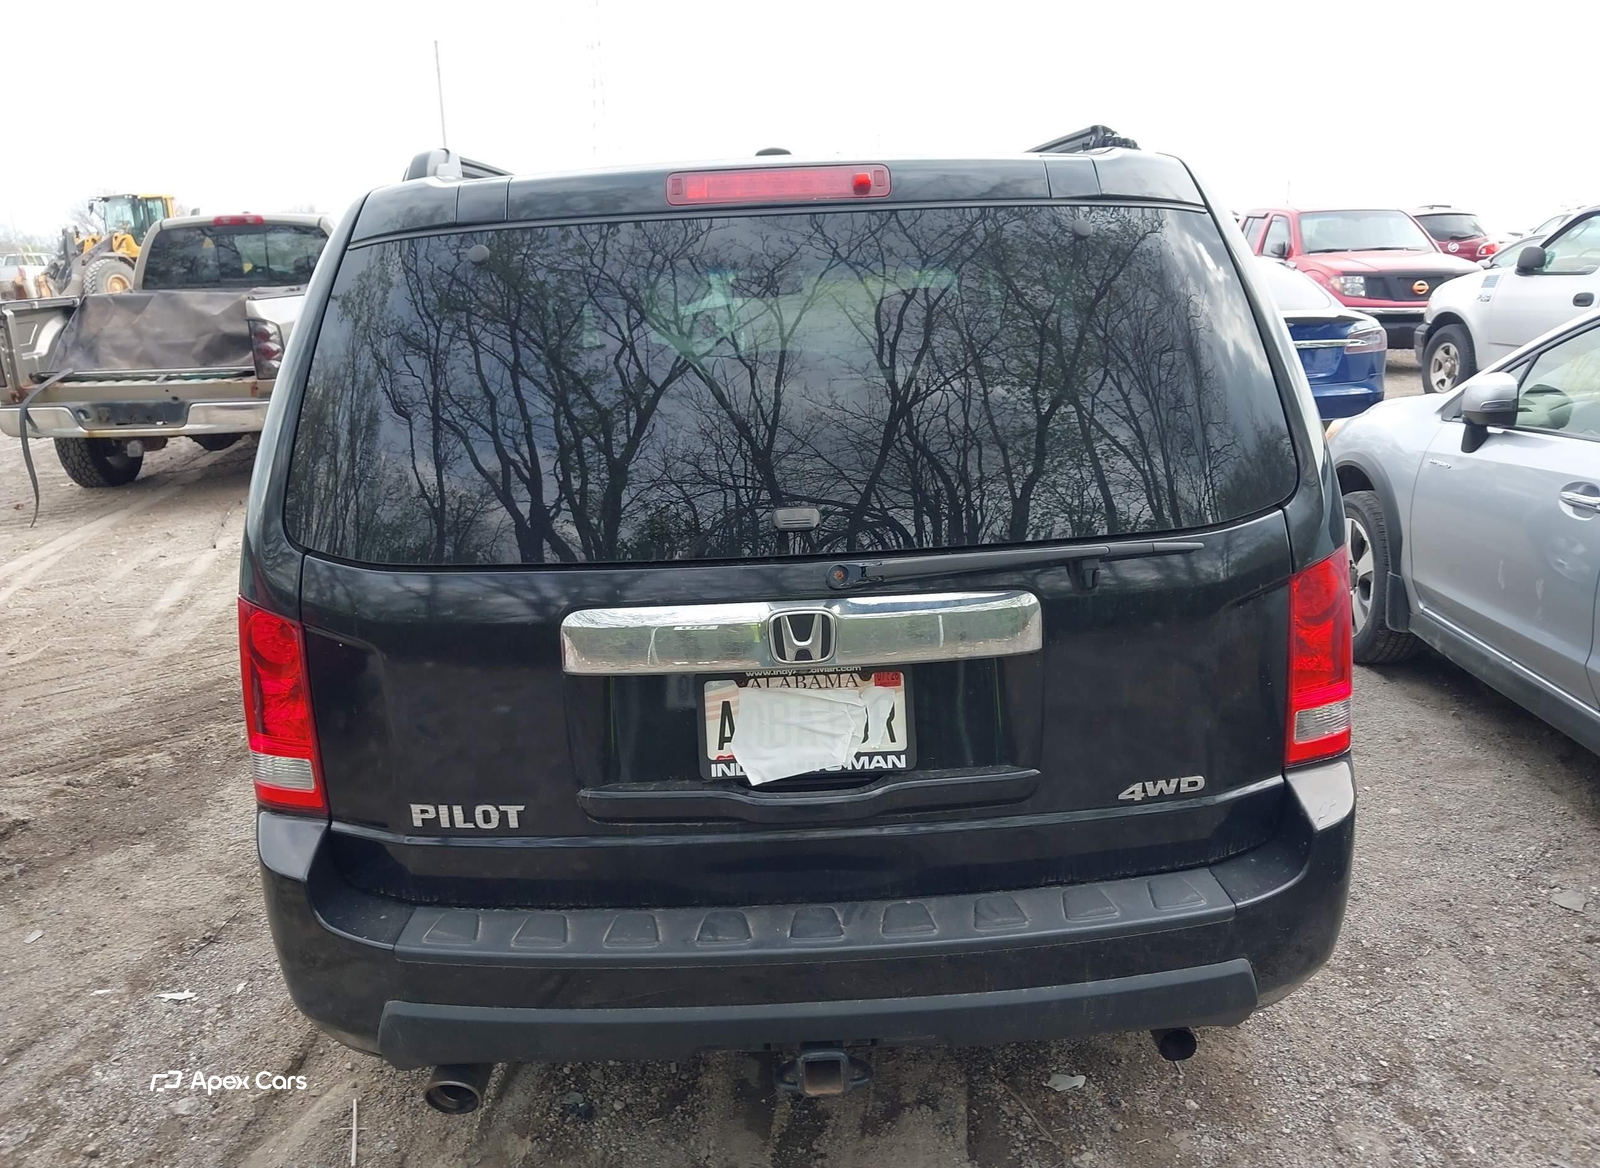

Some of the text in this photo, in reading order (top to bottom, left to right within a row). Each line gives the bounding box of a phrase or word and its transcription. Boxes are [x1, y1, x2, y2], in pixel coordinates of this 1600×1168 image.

[751, 673, 861, 689] ALABAMA
[1117, 775, 1206, 802] 4WD
[409, 803, 526, 829] PILOT
